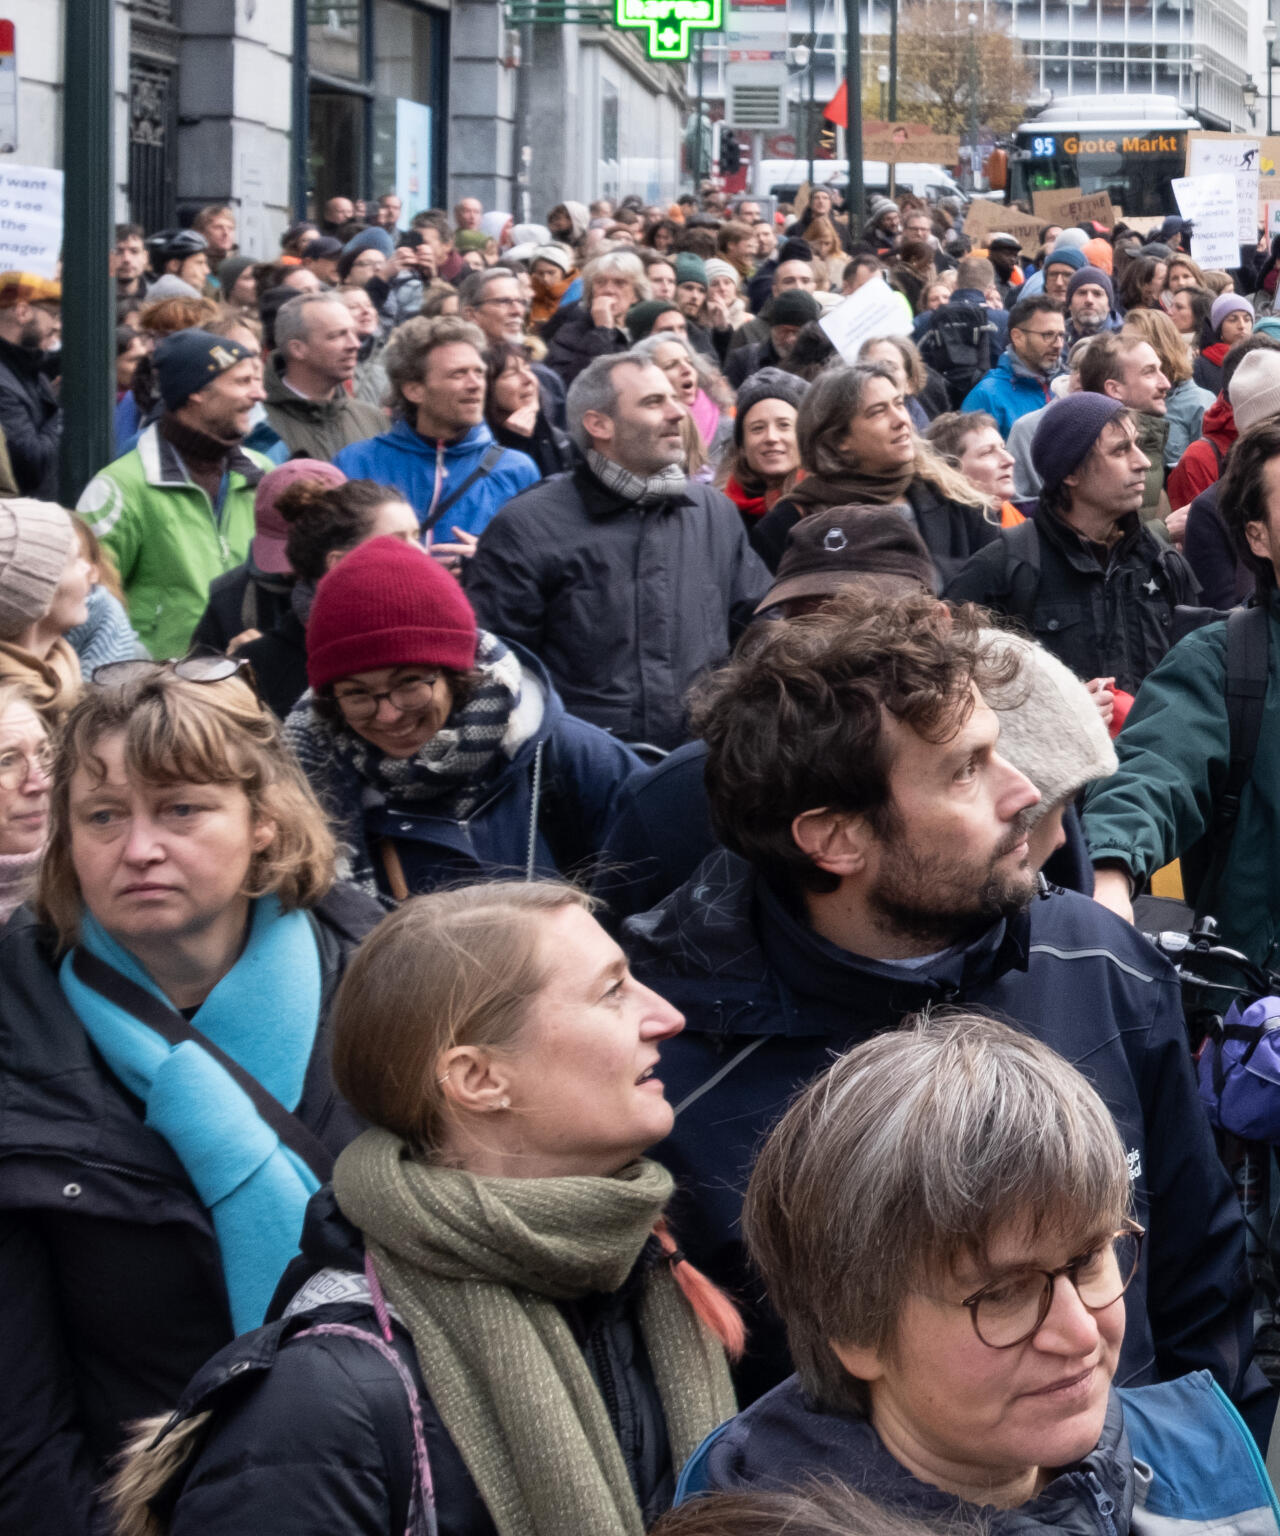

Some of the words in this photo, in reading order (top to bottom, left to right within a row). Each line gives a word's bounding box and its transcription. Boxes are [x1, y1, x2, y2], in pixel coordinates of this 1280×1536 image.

[1034, 137, 1055, 155] 95
[1064, 138, 1117, 154] Grote
[1123, 136, 1177, 152] Markt
[7, 179, 47, 190] want
[15, 201, 42, 212] see
[1, 220, 27, 231] the
